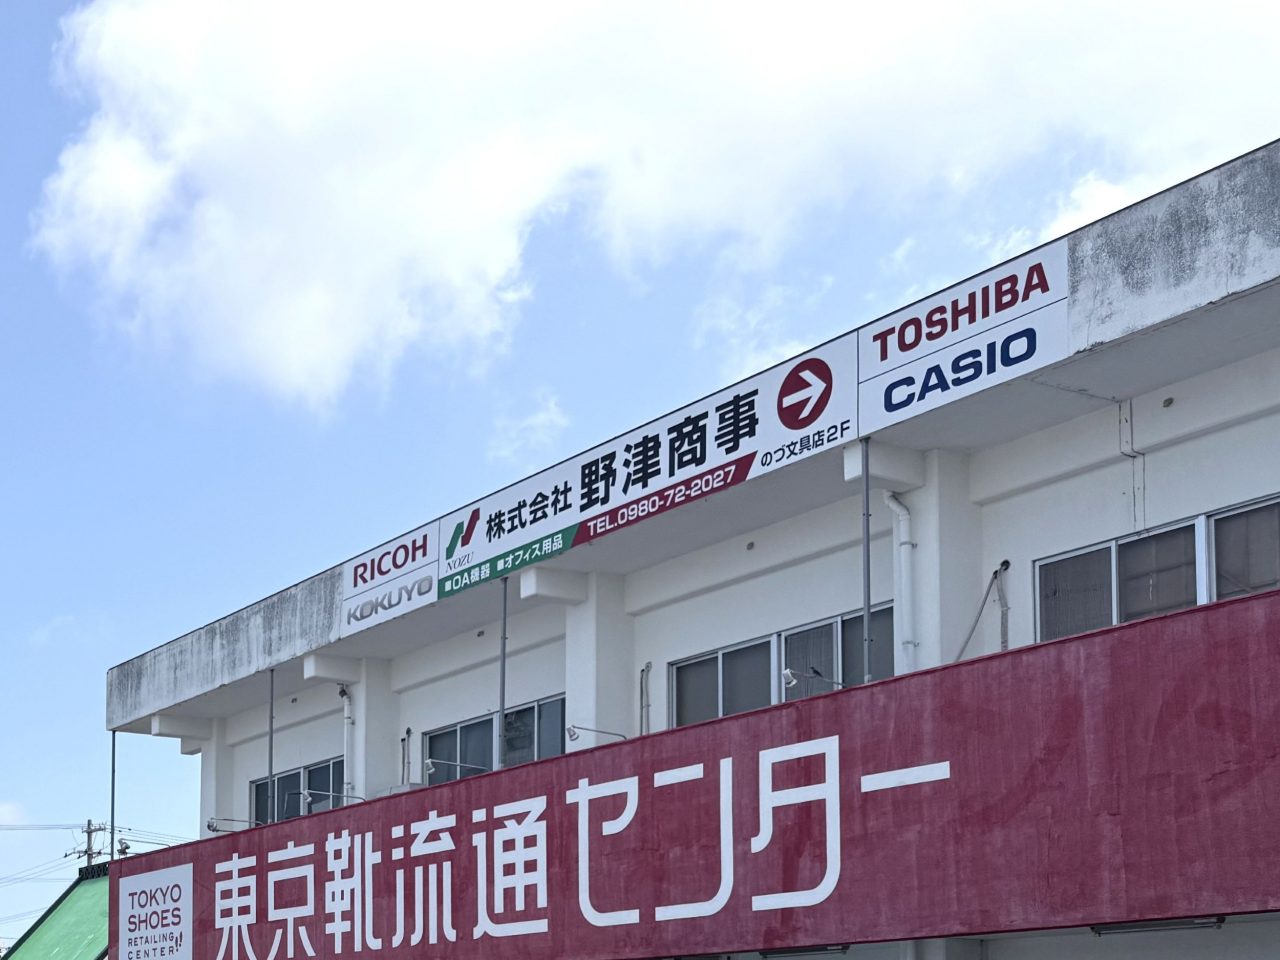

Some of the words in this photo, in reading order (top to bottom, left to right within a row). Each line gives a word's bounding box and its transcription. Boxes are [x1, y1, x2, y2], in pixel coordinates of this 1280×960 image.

[872, 262, 1050, 362] TOSHIBA
[883, 327, 1037, 413] CASIO
[485, 480, 573, 543] 株式会社
[579, 388, 759, 513] 野津商事
[760, 419, 851, 467] のづ文具店2F
[587, 465, 737, 536] TEL.0980-72-2027
[352, 533, 428, 588] RICOH
[445, 552, 475, 573] NOZU
[504, 533, 563, 569] オフィス用品
[346, 575, 433, 626] KOKUYO
[127, 907, 182, 933] SHOES
[128, 883, 182, 910] TOKYO
[127, 931, 175, 948] RETAILING
[127, 946, 175, 960] CENTER
